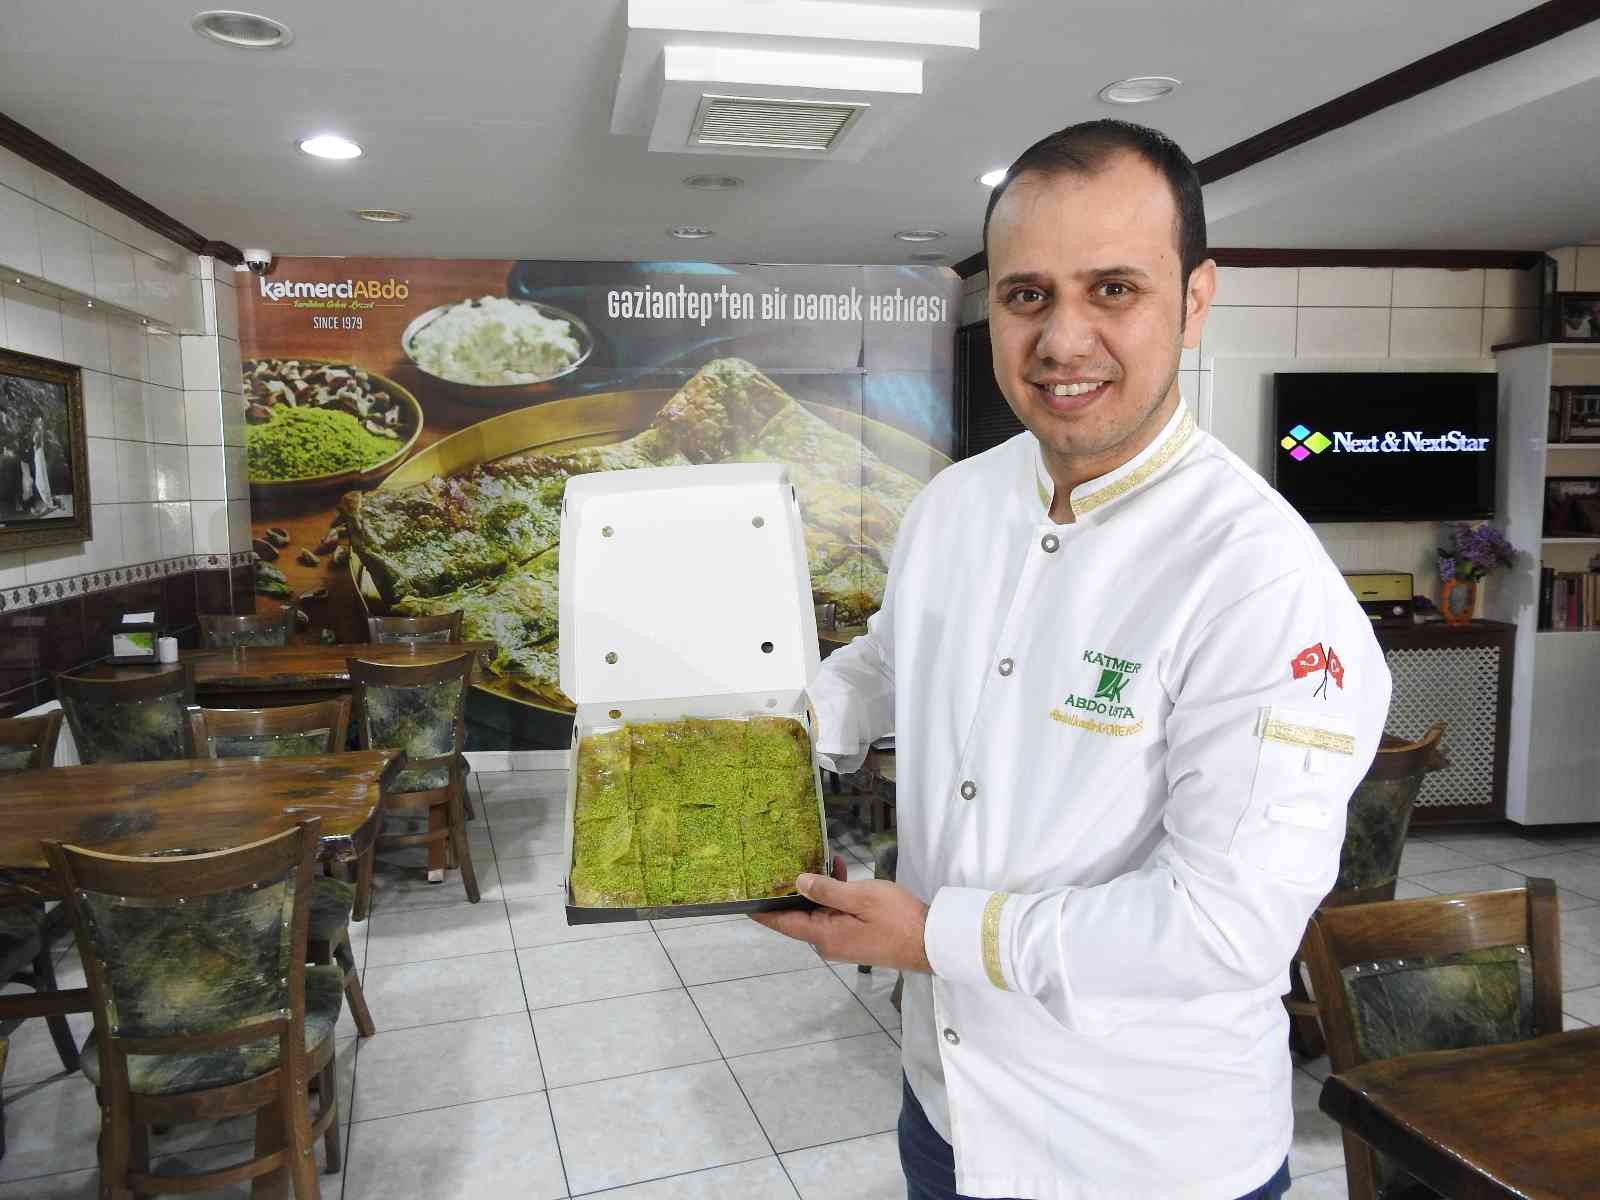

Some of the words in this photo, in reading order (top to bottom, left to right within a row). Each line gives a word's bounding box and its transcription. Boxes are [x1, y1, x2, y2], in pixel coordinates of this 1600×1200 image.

[313, 316, 339, 329] SINCE
[342, 316, 363, 329] 1979
[1332, 431, 1379, 453] Next
[1380, 431, 1401, 452] &
[1402, 430, 1490, 452] NextStar
[1064, 693, 1107, 714] ABDO
